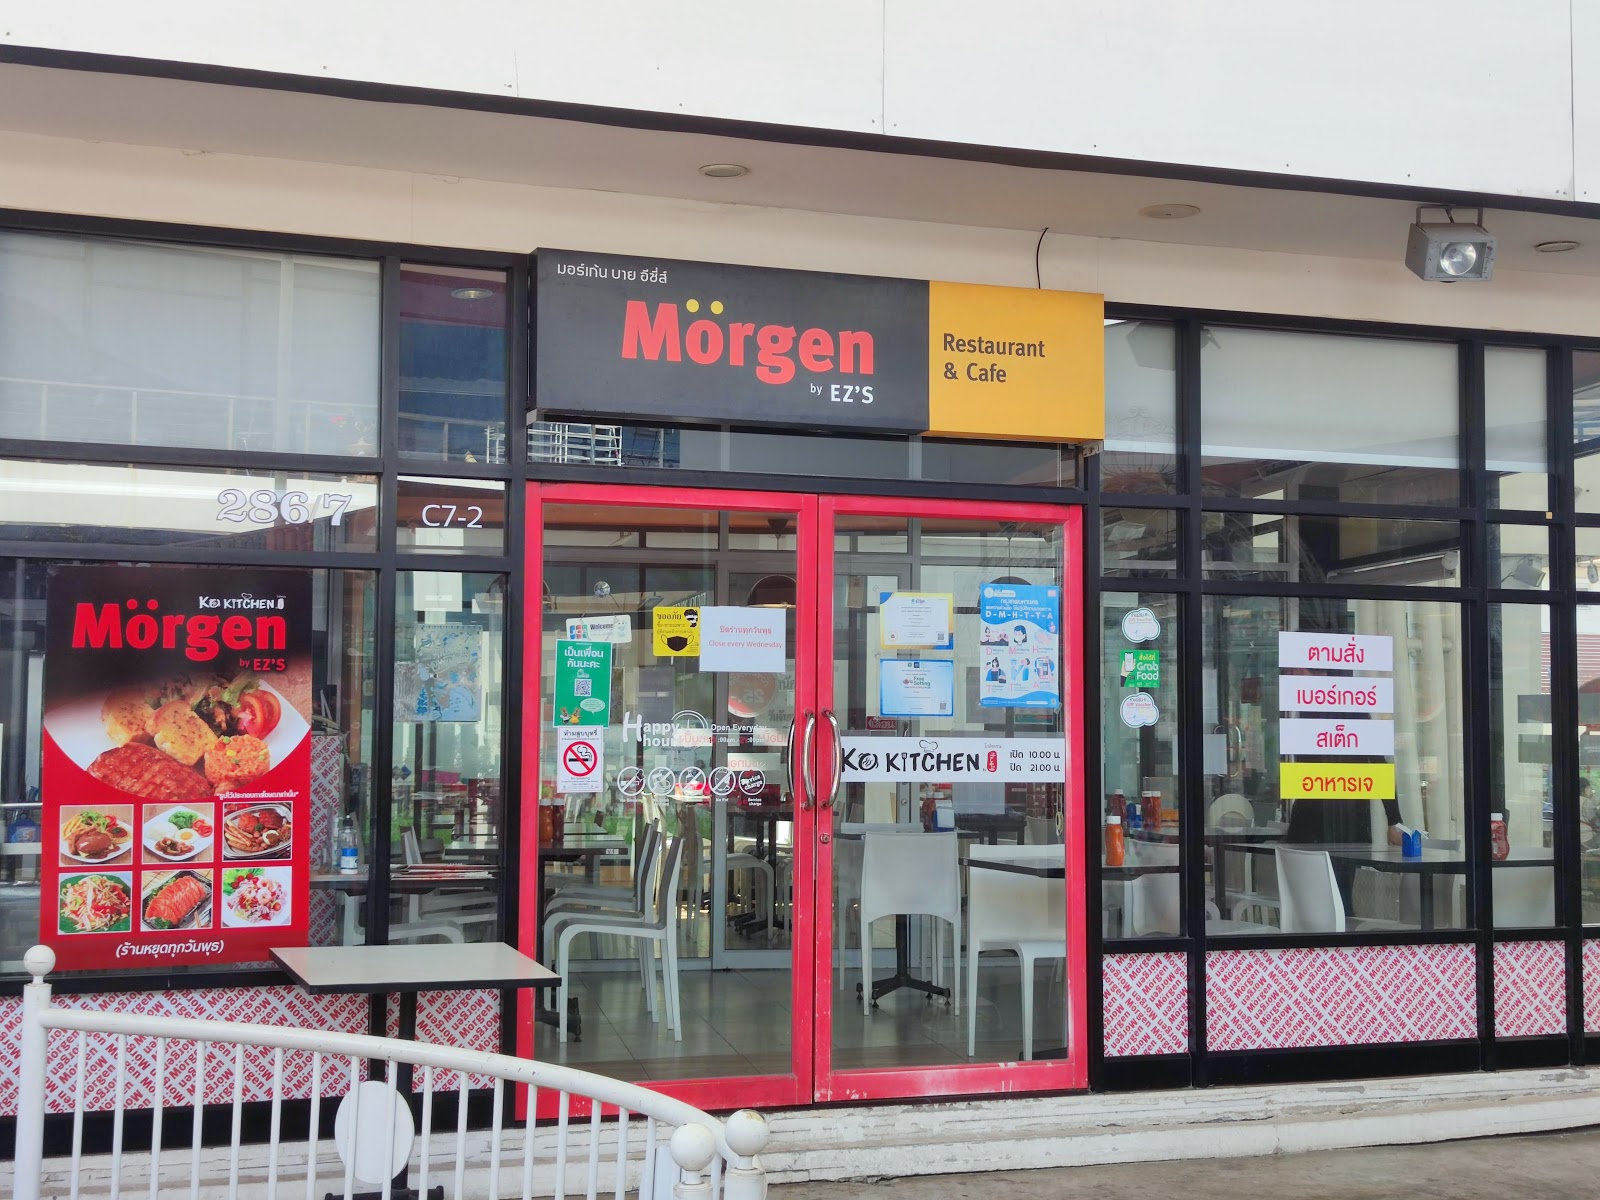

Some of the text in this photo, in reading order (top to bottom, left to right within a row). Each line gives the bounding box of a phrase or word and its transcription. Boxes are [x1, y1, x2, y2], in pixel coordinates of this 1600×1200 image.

[557, 263, 608, 279] มอร์เก้น
[611, 268, 637, 281] บาย
[621, 298, 874, 384] Mörgen
[943, 332, 1046, 358] Restaurant
[943, 362, 1007, 383] & Cafe
[808, 381, 824, 396] by
[421, 504, 483, 529] C7-2
[656, 610, 682, 620] ขออภัย
[72, 599, 286, 662] Mörgen
[564, 646, 604, 658] เป็นเพื่อน
[727, 641, 745, 649] every
[746, 641, 783, 649] Wednesday
[1307, 637, 1365, 664] ตามสั่ง
[239, 658, 251, 668] by
[567, 658, 600, 668] กันนะคะ
[1136, 661, 1159, 671] Grab
[1136, 671, 1159, 680] Food
[1297, 685, 1377, 707] เบอร์เกอร์
[622, 711, 680, 742] Happy
[711, 723, 767, 733] Open Everyday
[1316, 725, 1359, 748] สเต็ก
[1009, 749, 1024, 759] เปิด
[1029, 751, 1051, 759] 10.00
[1009, 762, 1022, 772] ปิด
[1030, 763, 1051, 772] 21.00
[1301, 776, 1374, 793] อาหารเจ
[116, 939, 225, 959] (ร้านหยุดทุกวันพุธ)
